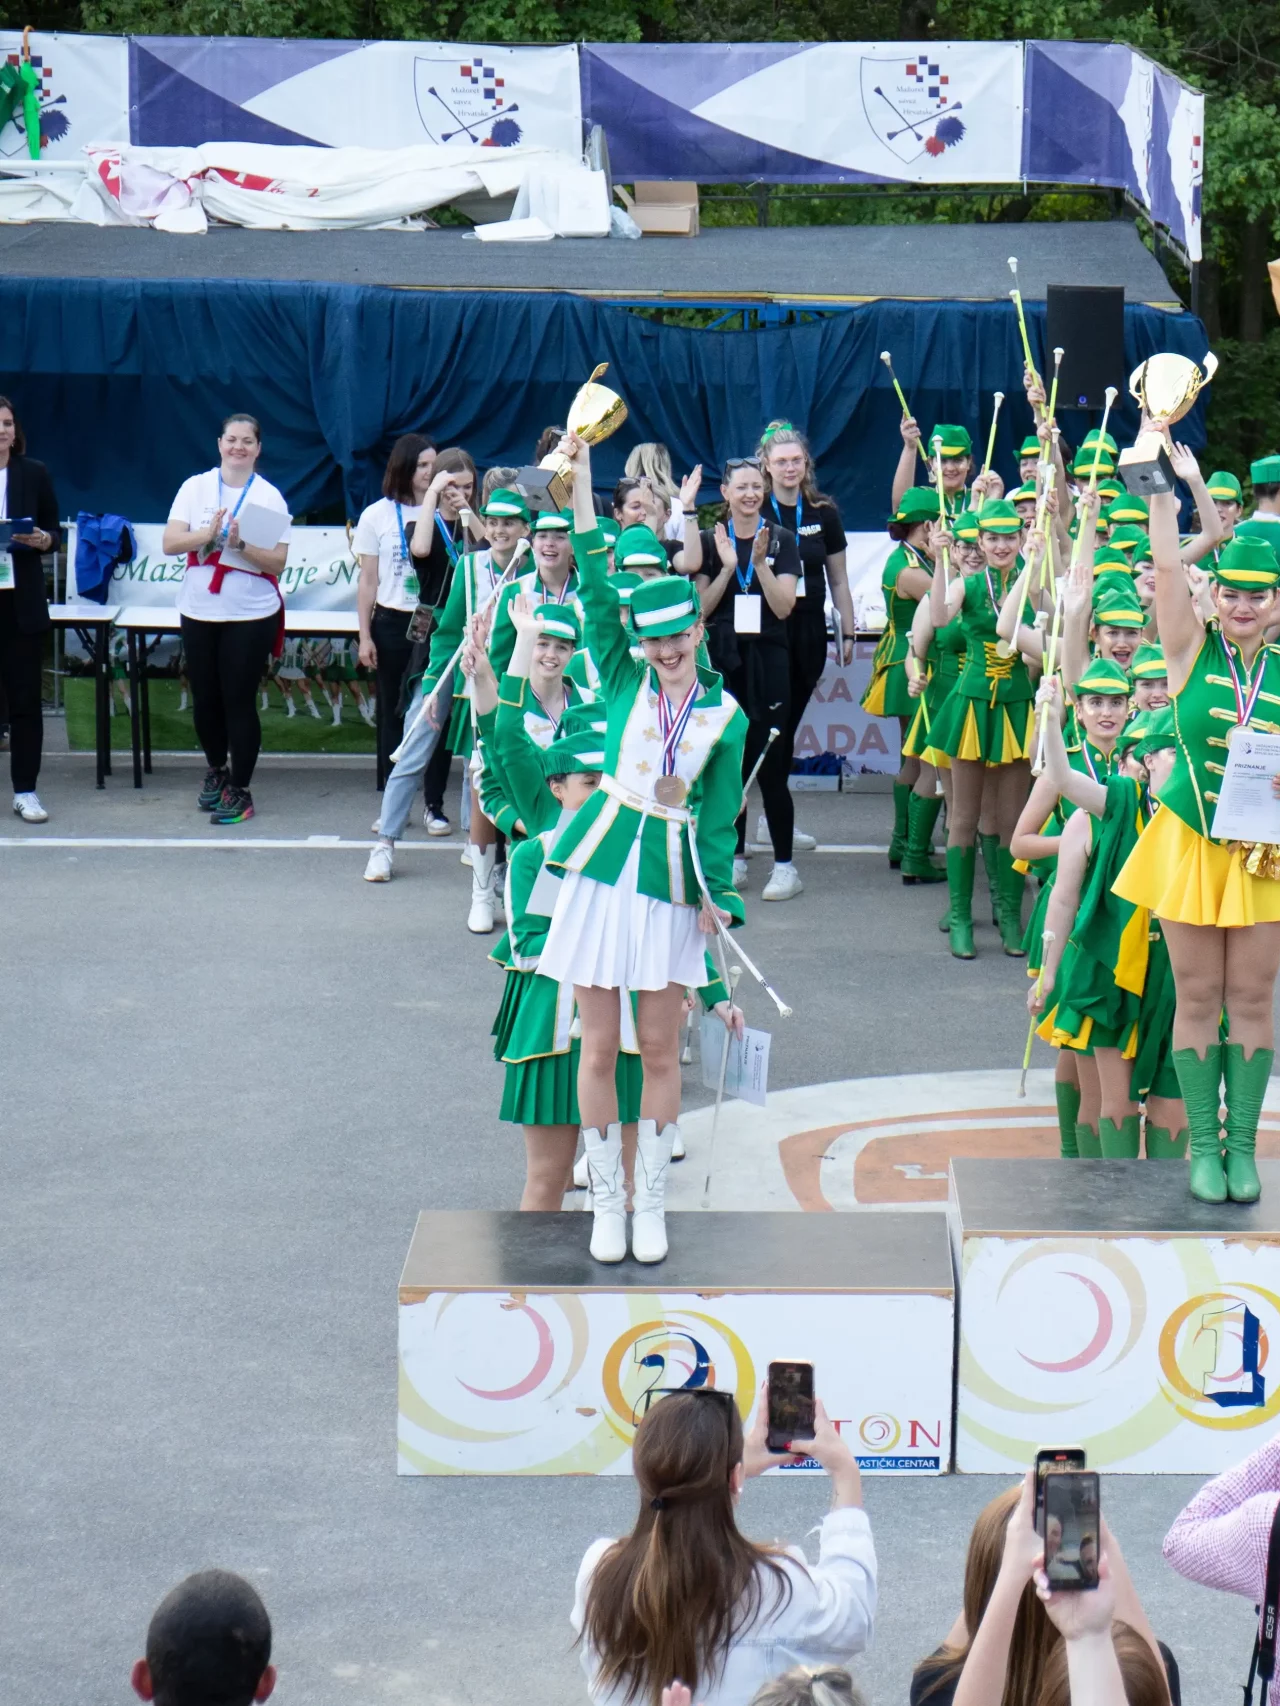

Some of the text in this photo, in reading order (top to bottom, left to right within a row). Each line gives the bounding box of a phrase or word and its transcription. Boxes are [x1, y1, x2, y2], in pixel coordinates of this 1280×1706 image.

[457, 109, 488, 117] Hrvatske
[112, 553, 185, 583] Maž
[1234, 763, 1267, 771] PRIZNANJE
[1202, 1303, 1265, 1408] 1
[632, 1331, 710, 1428] 2
[830, 1412, 941, 1453] TON
[856, 1456, 896, 1468] ASTIČKI
[898, 1459, 936, 1468] CENTAR
[1265, 1615, 1275, 1640] EOS
